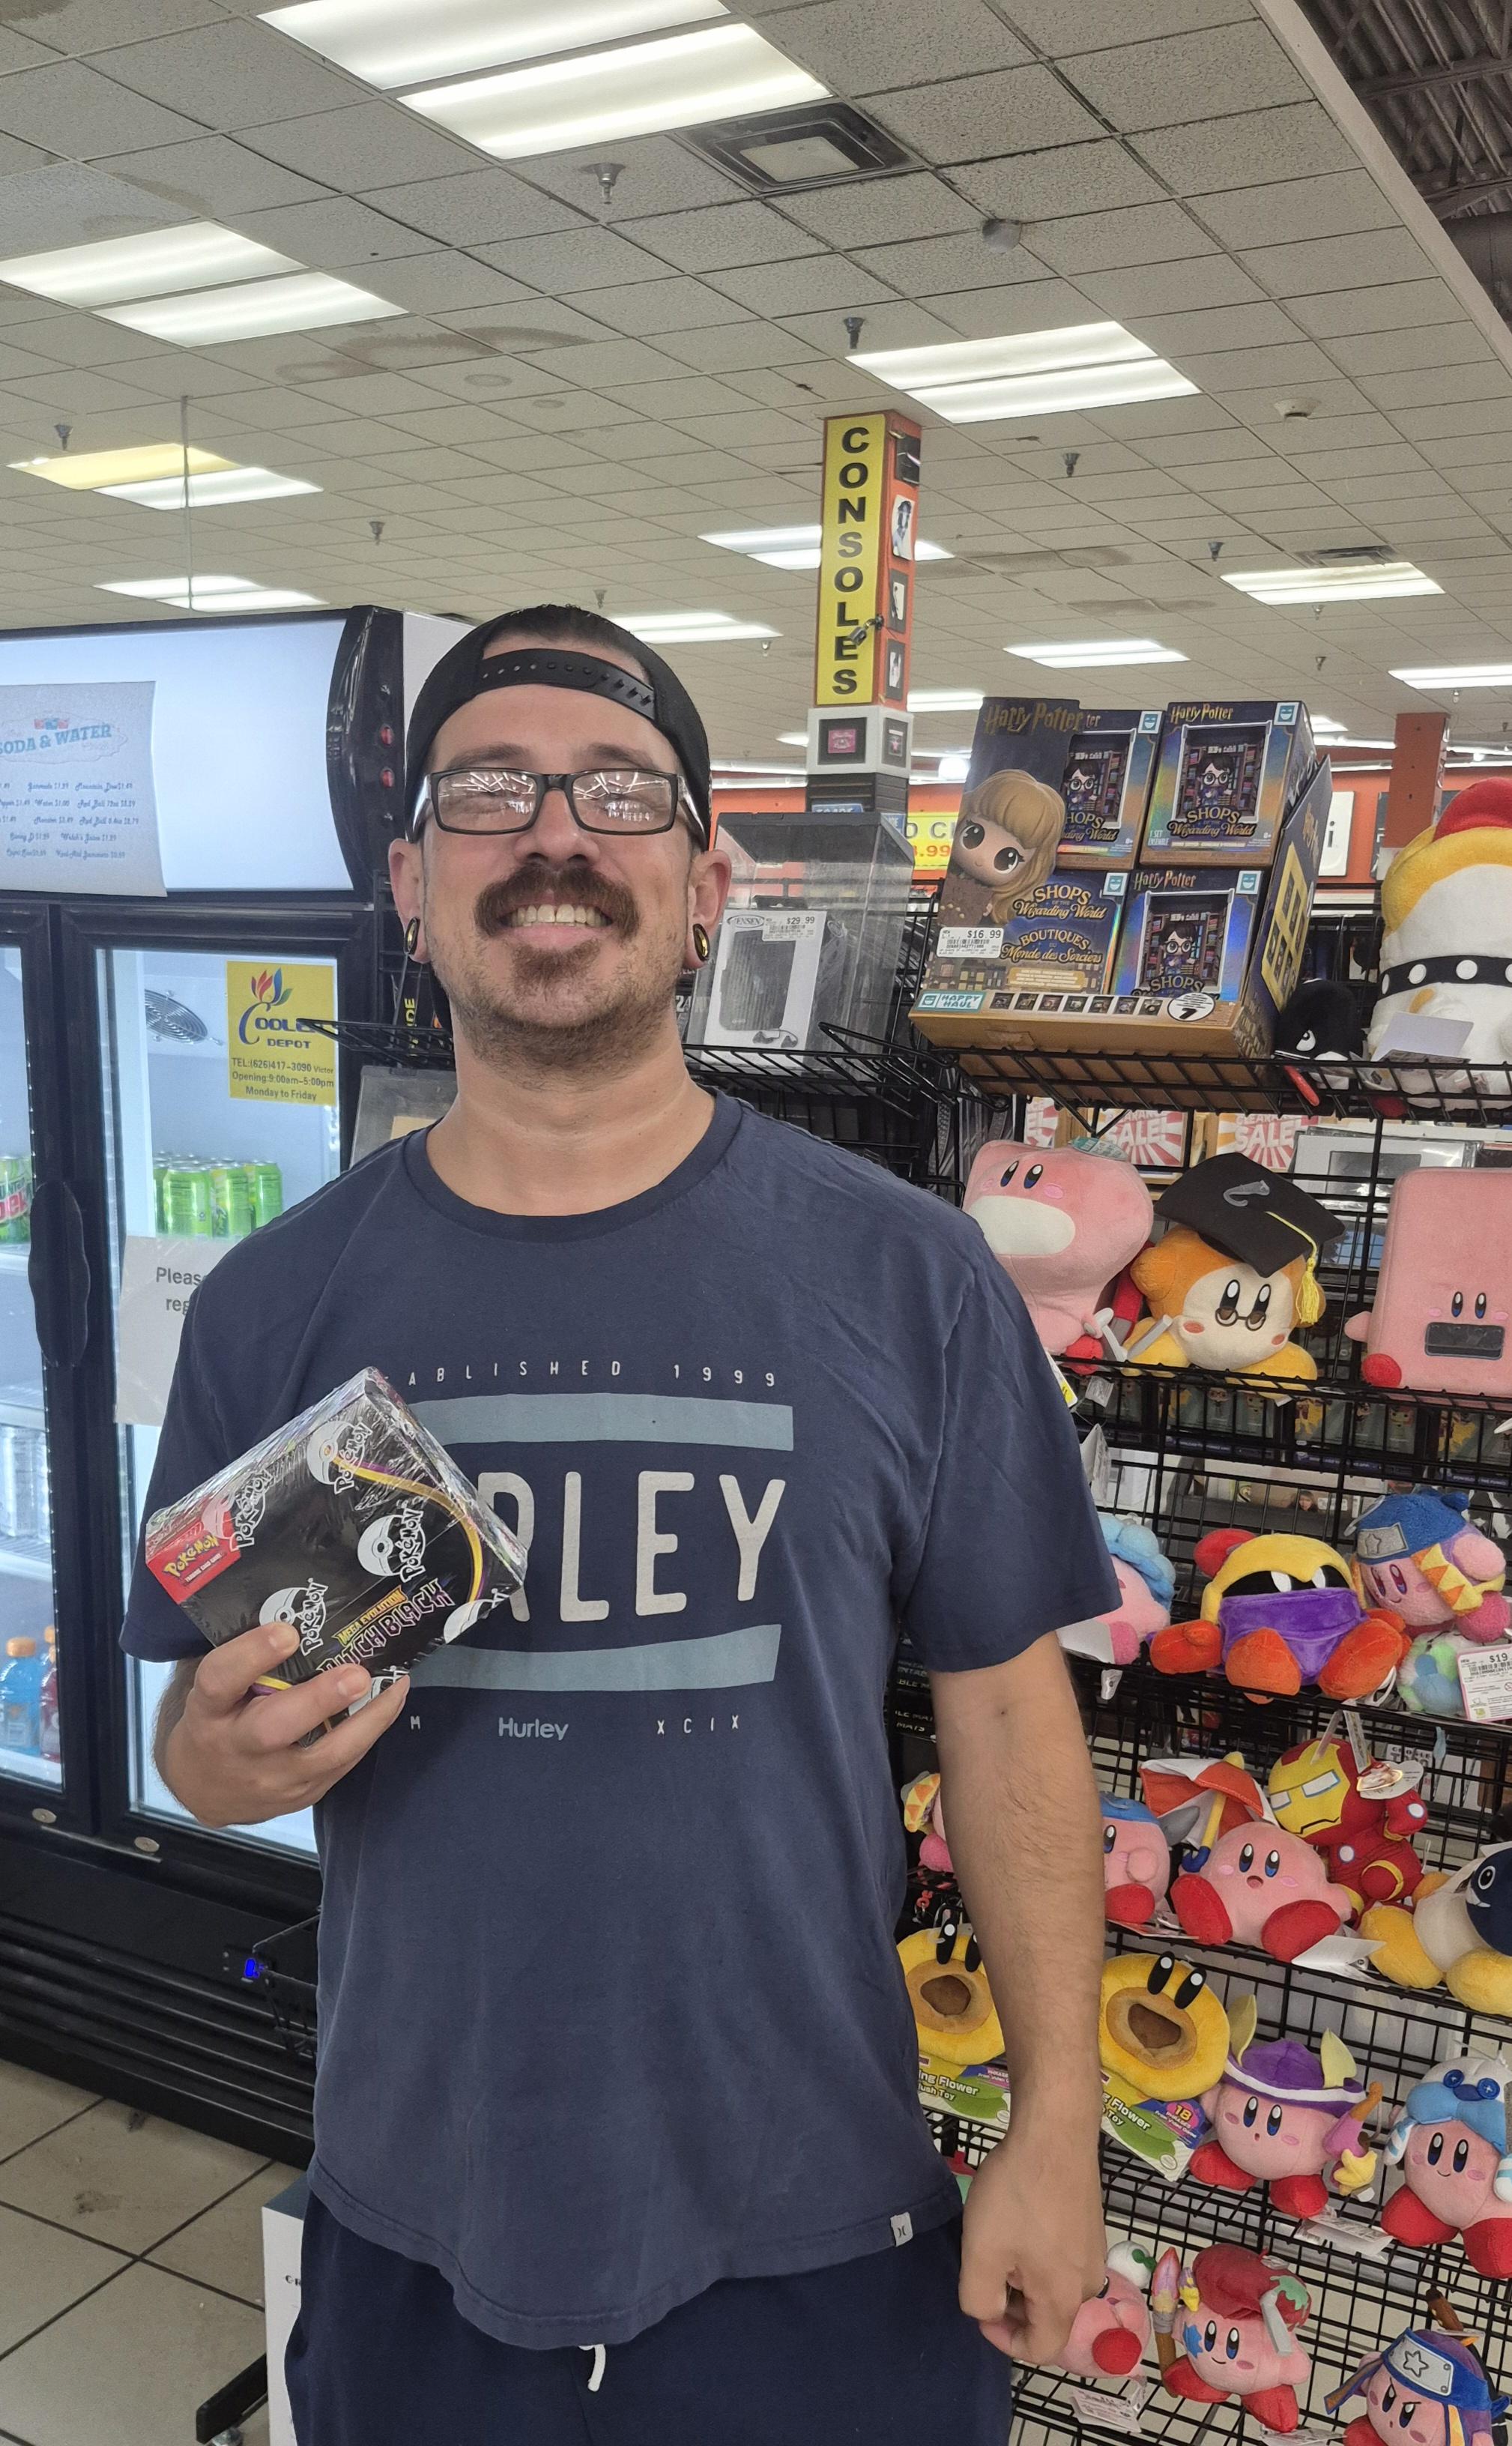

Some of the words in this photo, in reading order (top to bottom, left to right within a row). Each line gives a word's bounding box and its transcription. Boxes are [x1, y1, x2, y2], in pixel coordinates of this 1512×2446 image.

[832, 427, 869, 695] CONSOLES
[984, 704, 1031, 735] Harry
[1031, 702, 1083, 732] Potter
[1086, 713, 1101, 728] ter
[1170, 705, 1201, 724] Harry
[1200, 703, 1233, 722] Potter
[40, 734, 51, 749] &
[55, 723, 112, 745] WATER
[1187, 806, 1241, 824] SHOPS
[1086, 827, 1118, 840] World
[1168, 822, 1221, 838] Wizarding
[1221, 823, 1256, 837] World
[1133, 872, 1164, 891] Harry
[1164, 870, 1197, 890] Potter
[1035, 884, 1092, 905] SHOPS
[1014, 901, 1070, 920] Wizarding
[1070, 903, 1107, 919] World
[1020, 929, 1089, 950] BOUTIQUES
[1001, 943, 1041, 962] Monde
[1041, 948, 1059, 961] des
[1059, 947, 1101, 963] Sorciers
[1150, 975, 1203, 992] SHOPS
[239, 1001, 324, 1045] COOLE
[1179, 1007, 1197, 1020] 7
[267, 1038, 312, 1049] DEPOT
[313, 1066, 333, 1075] Victor
[246, 1086, 279, 1097] Monday
[280, 1090, 289, 1098] to
[291, 1090, 317, 1101] Friday
[156, 1267, 202, 1286] Pleas
[166, 1299, 189, 1316] reg
[408, 1360, 620, 1386] ABLISHED
[673, 1364, 775, 1387] 1999
[399, 1506, 426, 1583] Pokémon
[477, 1471, 786, 1622] RLEY
[163, 1535, 220, 1577] Pokémon
[337, 1623, 363, 1643] MEGA
[360, 1589, 404, 1625] EVOLUTION
[378, 1578, 456, 1637] BLACK
[300, 1582, 329, 1656] Pokémon
[498, 1717, 569, 1741] Hurley
[657, 1715, 740, 1735] XCIX
[919, 2084, 937, 2096] lush
[938, 2089, 955, 2101] Toy
[939, 2076, 979, 2096] Flower
[1107, 2110, 1125, 2127] Toy
[1110, 2098, 1151, 2131] Flower
[1175, 2104, 1193, 2122] 18
